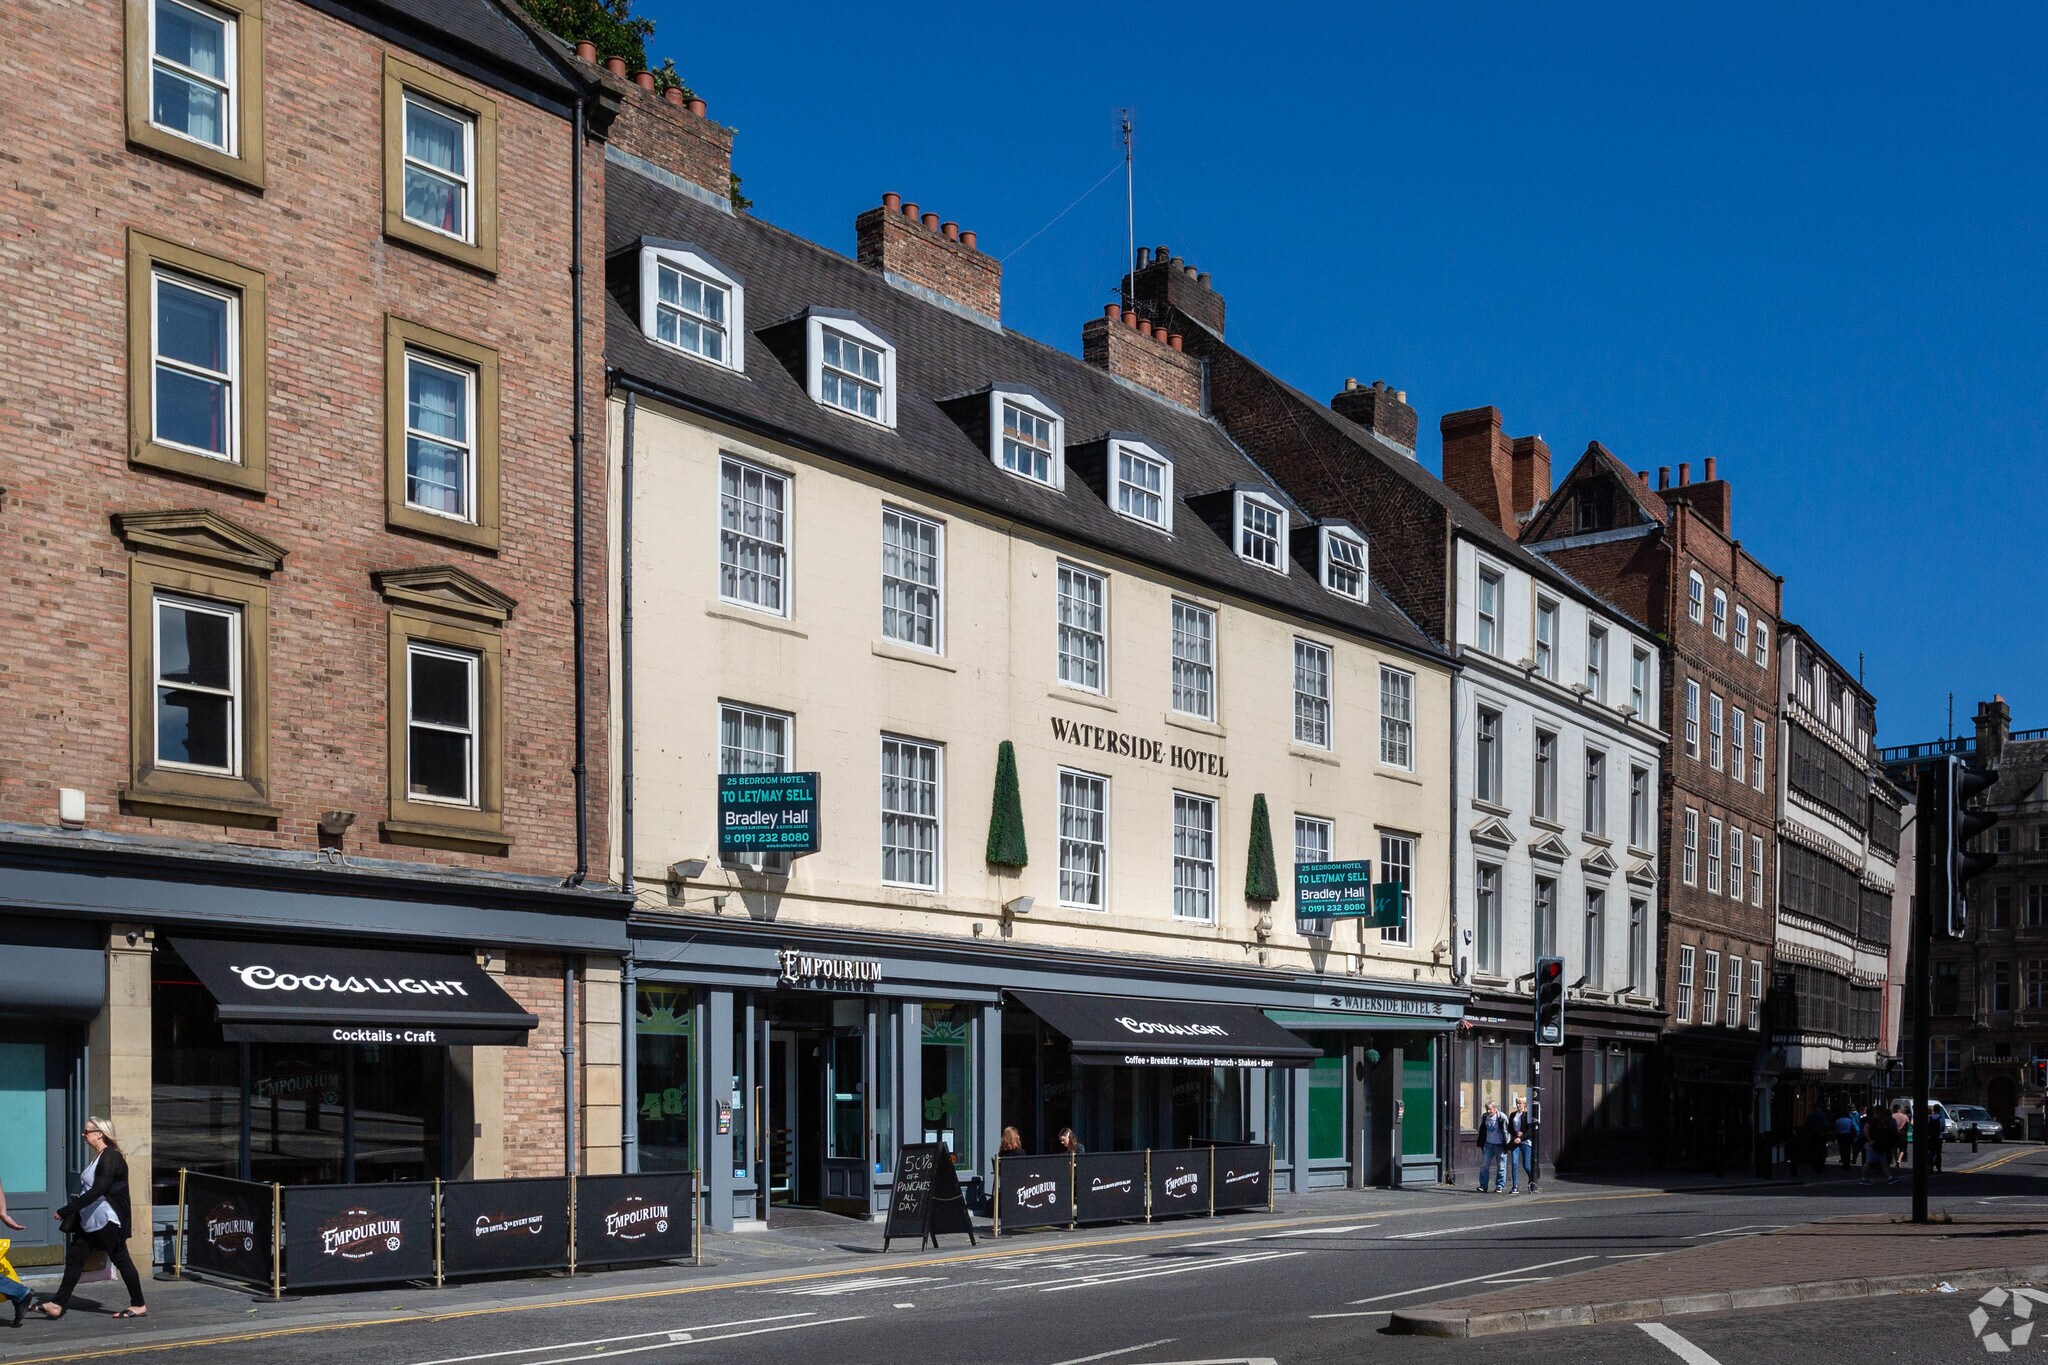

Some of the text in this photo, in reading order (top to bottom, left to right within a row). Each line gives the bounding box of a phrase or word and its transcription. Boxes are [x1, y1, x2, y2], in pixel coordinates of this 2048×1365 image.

[1050, 716, 1229, 778] WATERSIDE HOTEL
[739, 777, 778, 785] BEDROOM
[722, 789, 813, 803] TO LET/MAY SELL
[725, 809, 808, 829] Bradley Hall
[734, 832, 809, 843] 0191 232 8080
[1298, 872, 1367, 884] TO LET/MAY SELL
[1301, 889, 1341, 902] Bradley
[1344, 887, 1365, 898] Hall
[781, 949, 882, 983] EMPOURIUM
[230, 965, 469, 996] Coors LIGHT
[1344, 996, 1431, 1014] WATERSIDE HOTEL
[333, 1029, 436, 1042] Cocktails Craft
[1115, 1016, 1229, 1036] Coors LIGHT
[1125, 1056, 1274, 1067] Coffee Breakfast Pancakes Brunch Shakes Beer
[640, 1087, 682, 1120] 48
[904, 1153, 933, 1173] 50%
[1016, 1181, 1056, 1206] EMPOURIUM
[1165, 1173, 1198, 1195] EMPOURIUM
[903, 1193, 916, 1201] ALL
[898, 1202, 919, 1213] DAY
[207, 1218, 255, 1245] EMPOURIUM
[475, 1226, 489, 1237] OPEN
[489, 1223, 504, 1233] UNTIL
[512, 1218, 528, 1228] EVERY
[528, 1215, 543, 1225] NIGHT
[604, 1206, 669, 1237] EMPOURIUM
[321, 1220, 401, 1255] EMPOURIUM
